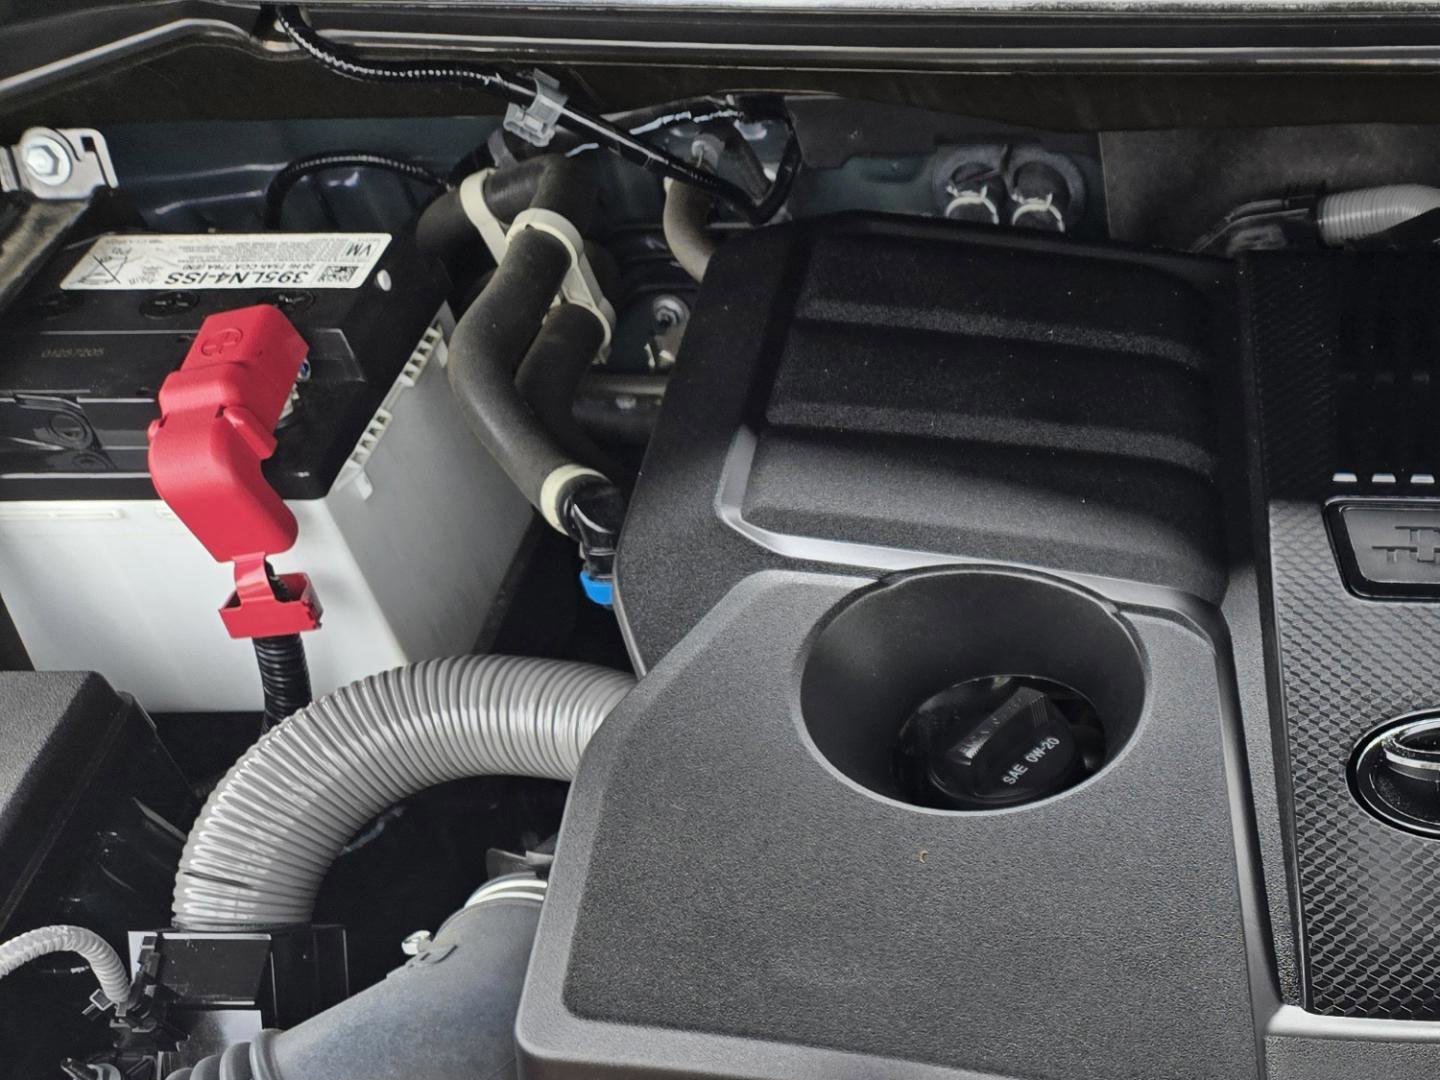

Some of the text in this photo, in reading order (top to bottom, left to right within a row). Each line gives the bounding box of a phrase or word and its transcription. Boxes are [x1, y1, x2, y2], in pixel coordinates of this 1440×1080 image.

[347, 245, 371, 256] VM
[165, 270, 308, 286] 395LN4-ISS
[1003, 736, 1061, 785] SAE 0W-20
